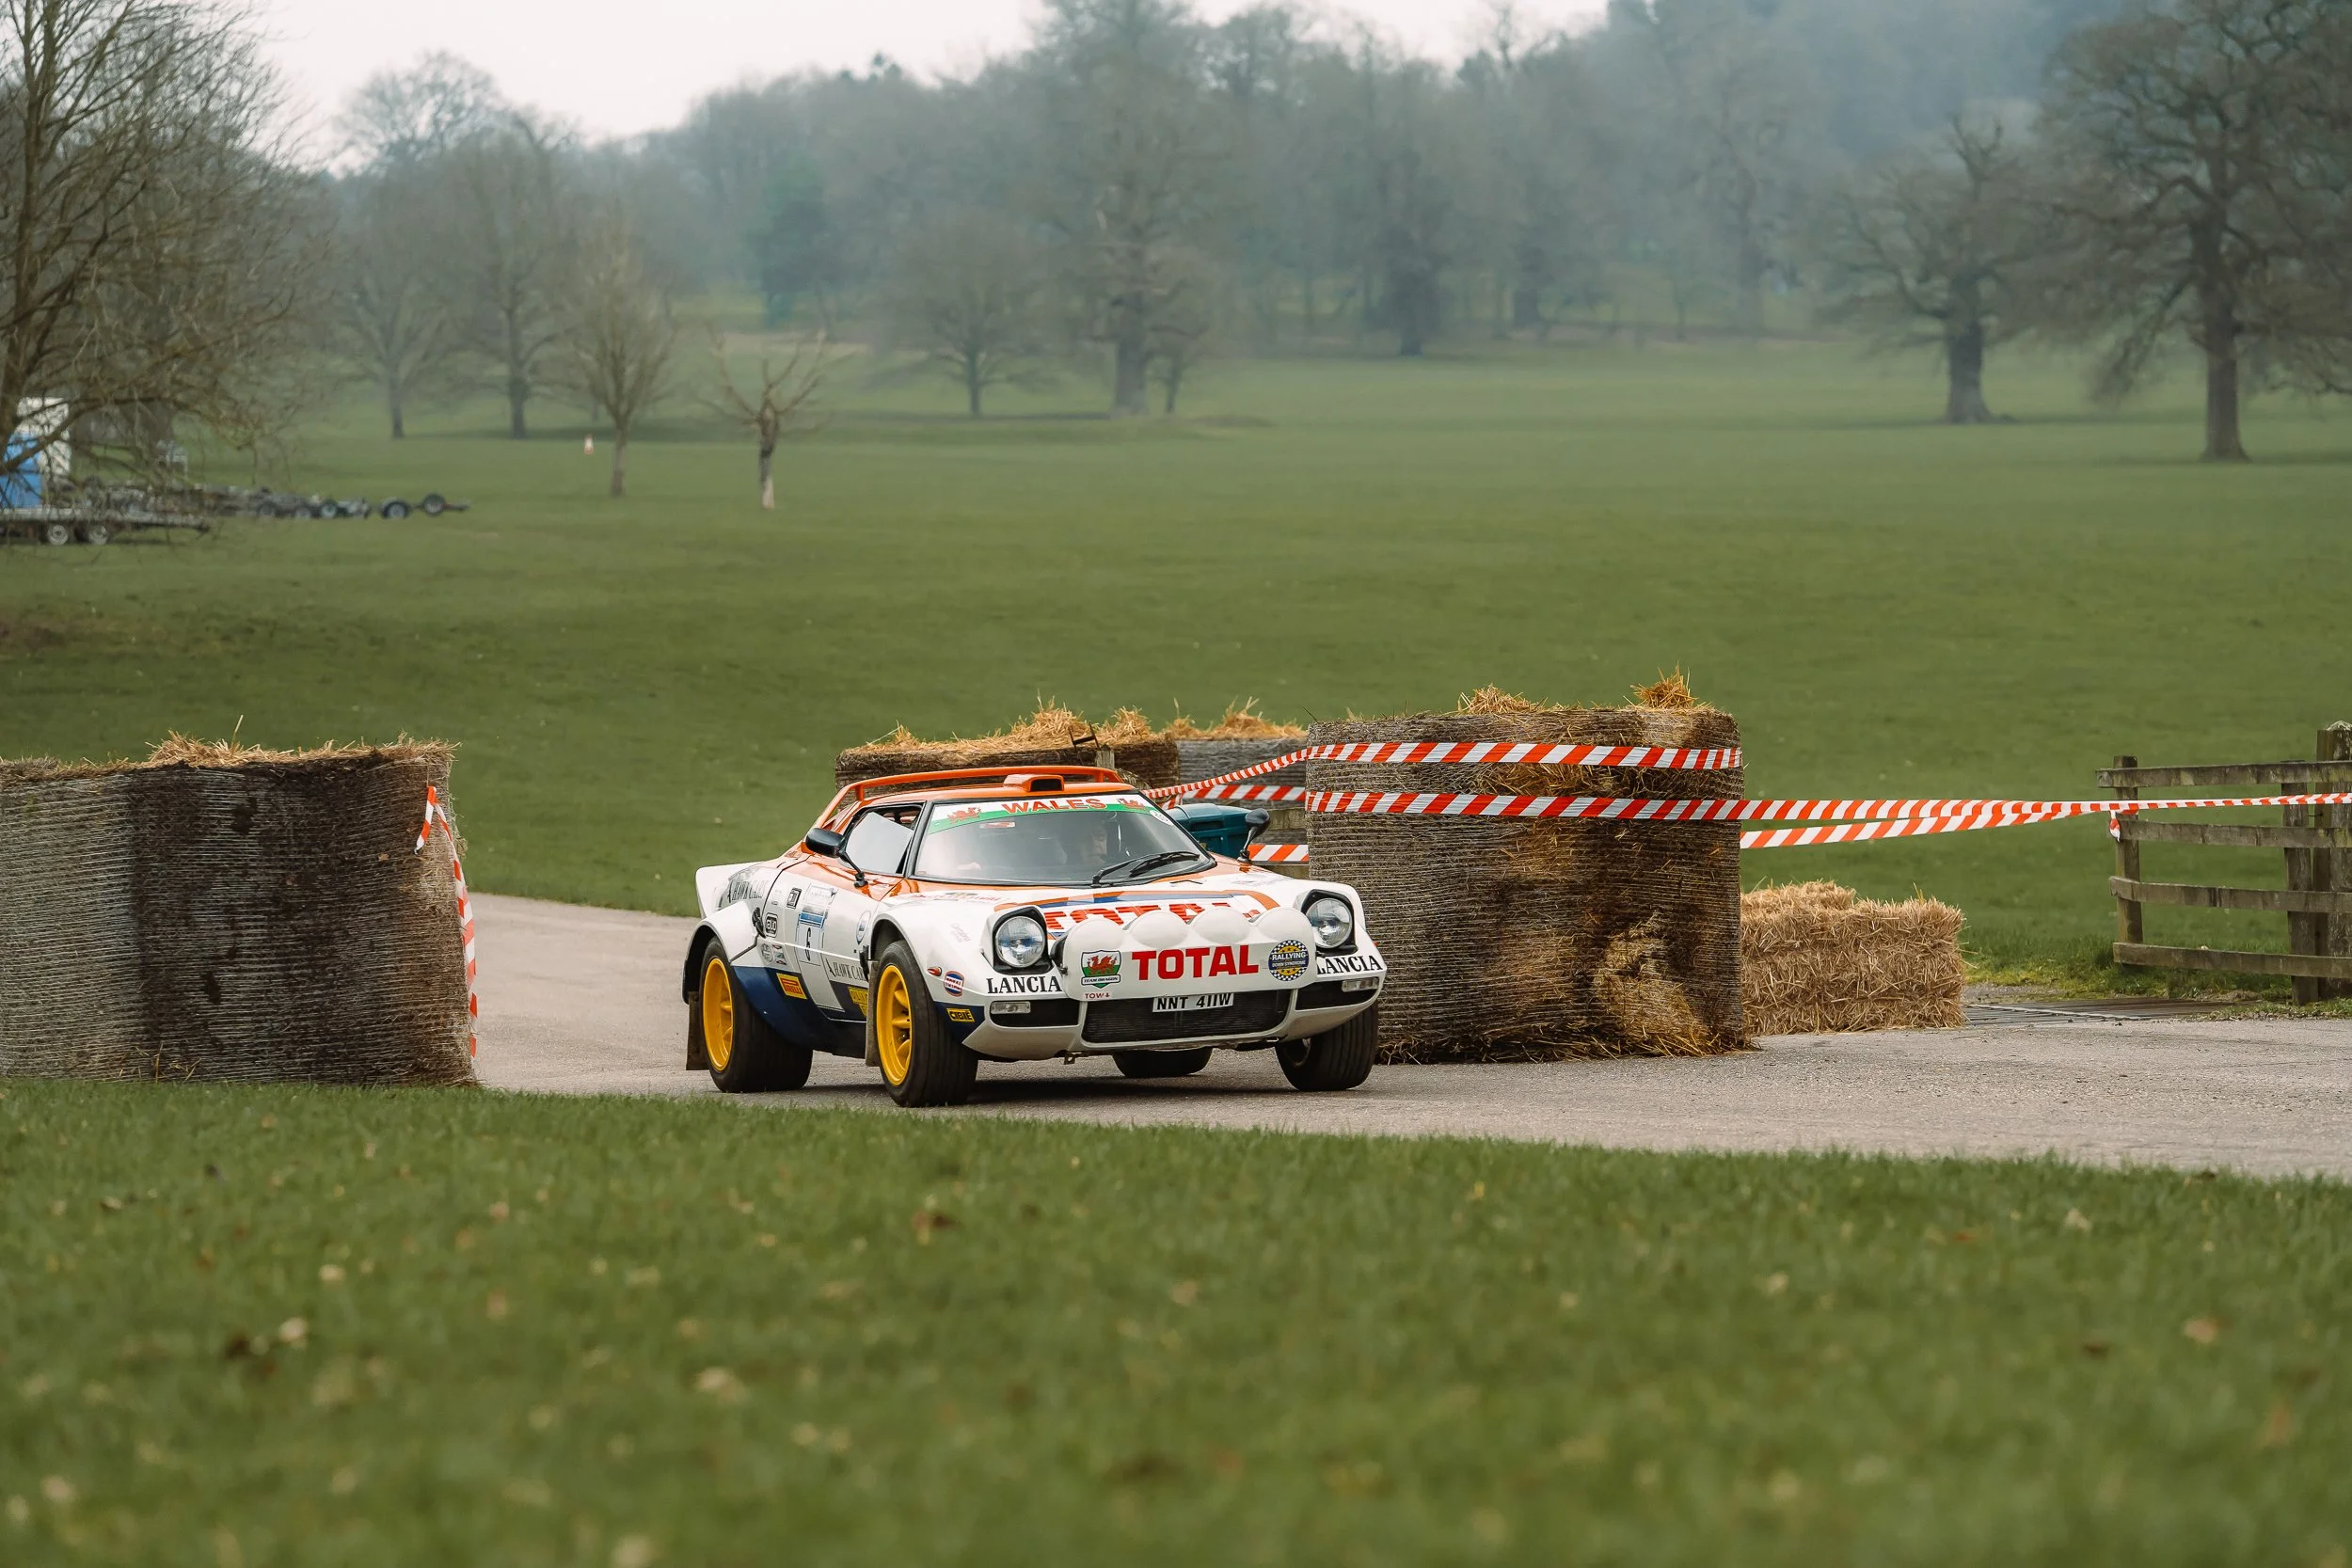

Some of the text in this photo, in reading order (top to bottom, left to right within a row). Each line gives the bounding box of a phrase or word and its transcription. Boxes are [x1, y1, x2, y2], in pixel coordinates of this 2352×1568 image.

[1001, 798, 1106, 815] WALES
[805, 927, 812, 961] 6
[1132, 944, 1259, 981] TOTAL
[1272, 952, 1307, 960] RALLYING
[1317, 955, 1383, 975] LANCIA
[833, 962, 866, 982] HAWK CAR
[986, 975, 1062, 994] LANCIA
[1156, 993, 1234, 1010] NNT 411W
